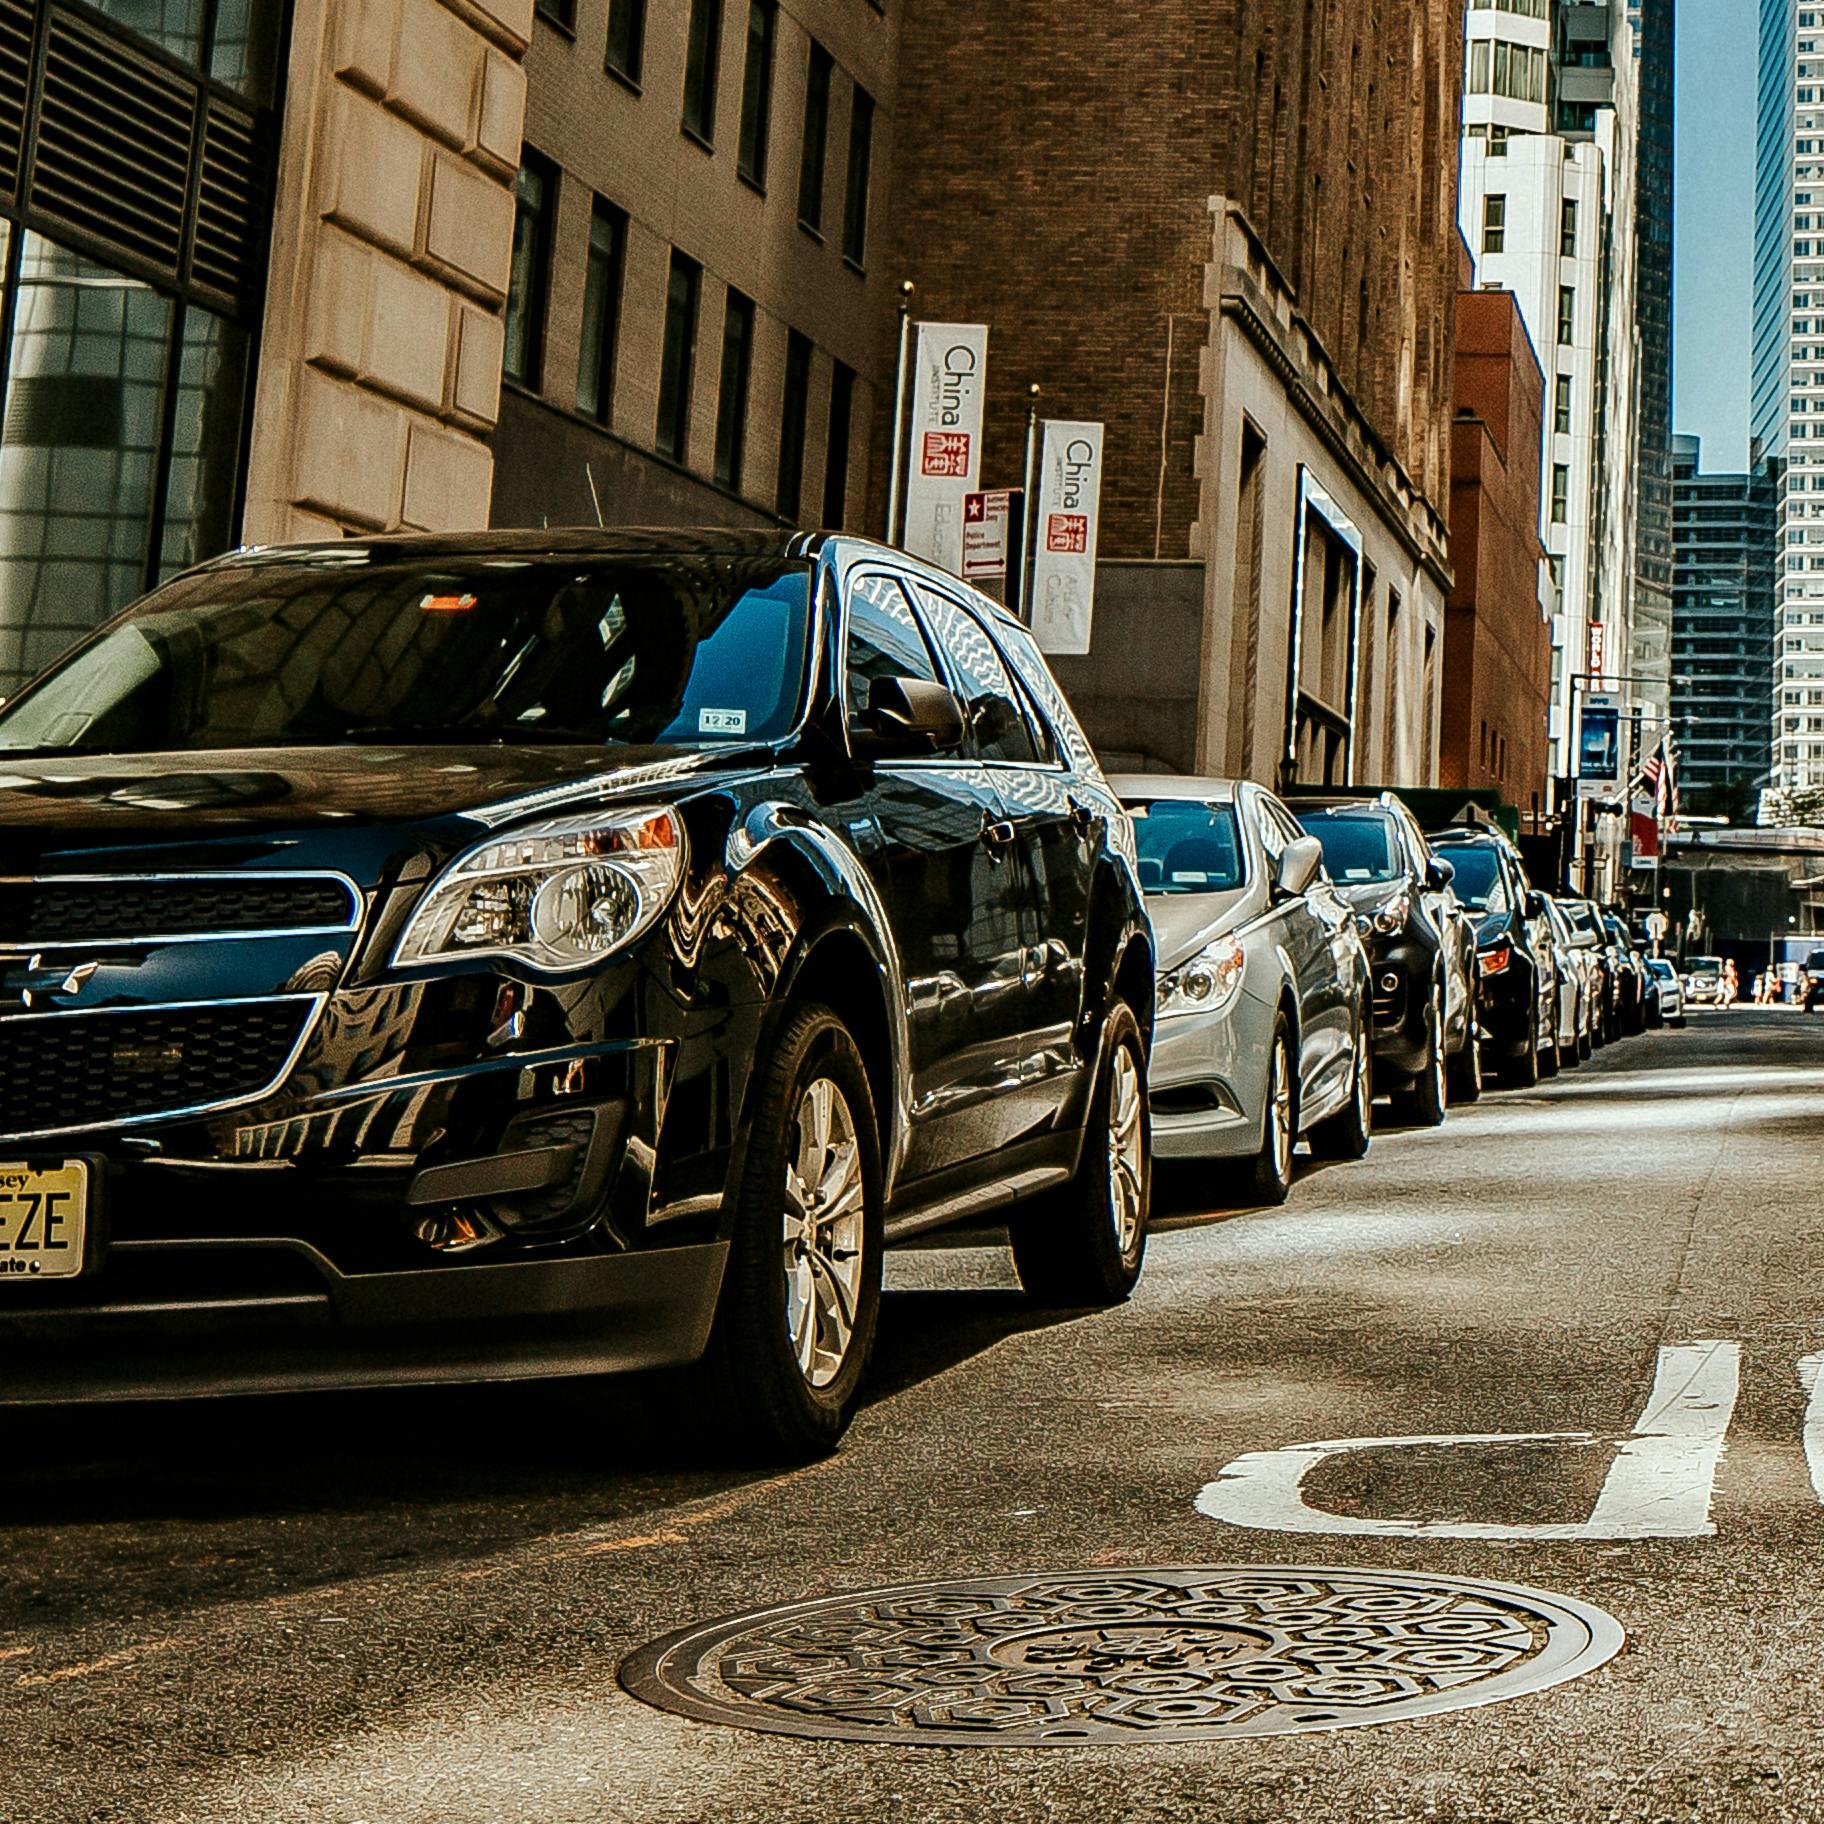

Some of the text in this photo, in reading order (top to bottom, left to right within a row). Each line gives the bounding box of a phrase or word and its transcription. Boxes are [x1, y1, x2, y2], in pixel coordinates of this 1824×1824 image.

[941, 344, 976, 426] China
[1063, 439, 1094, 509] China
[724, 716, 741, 726] 20
